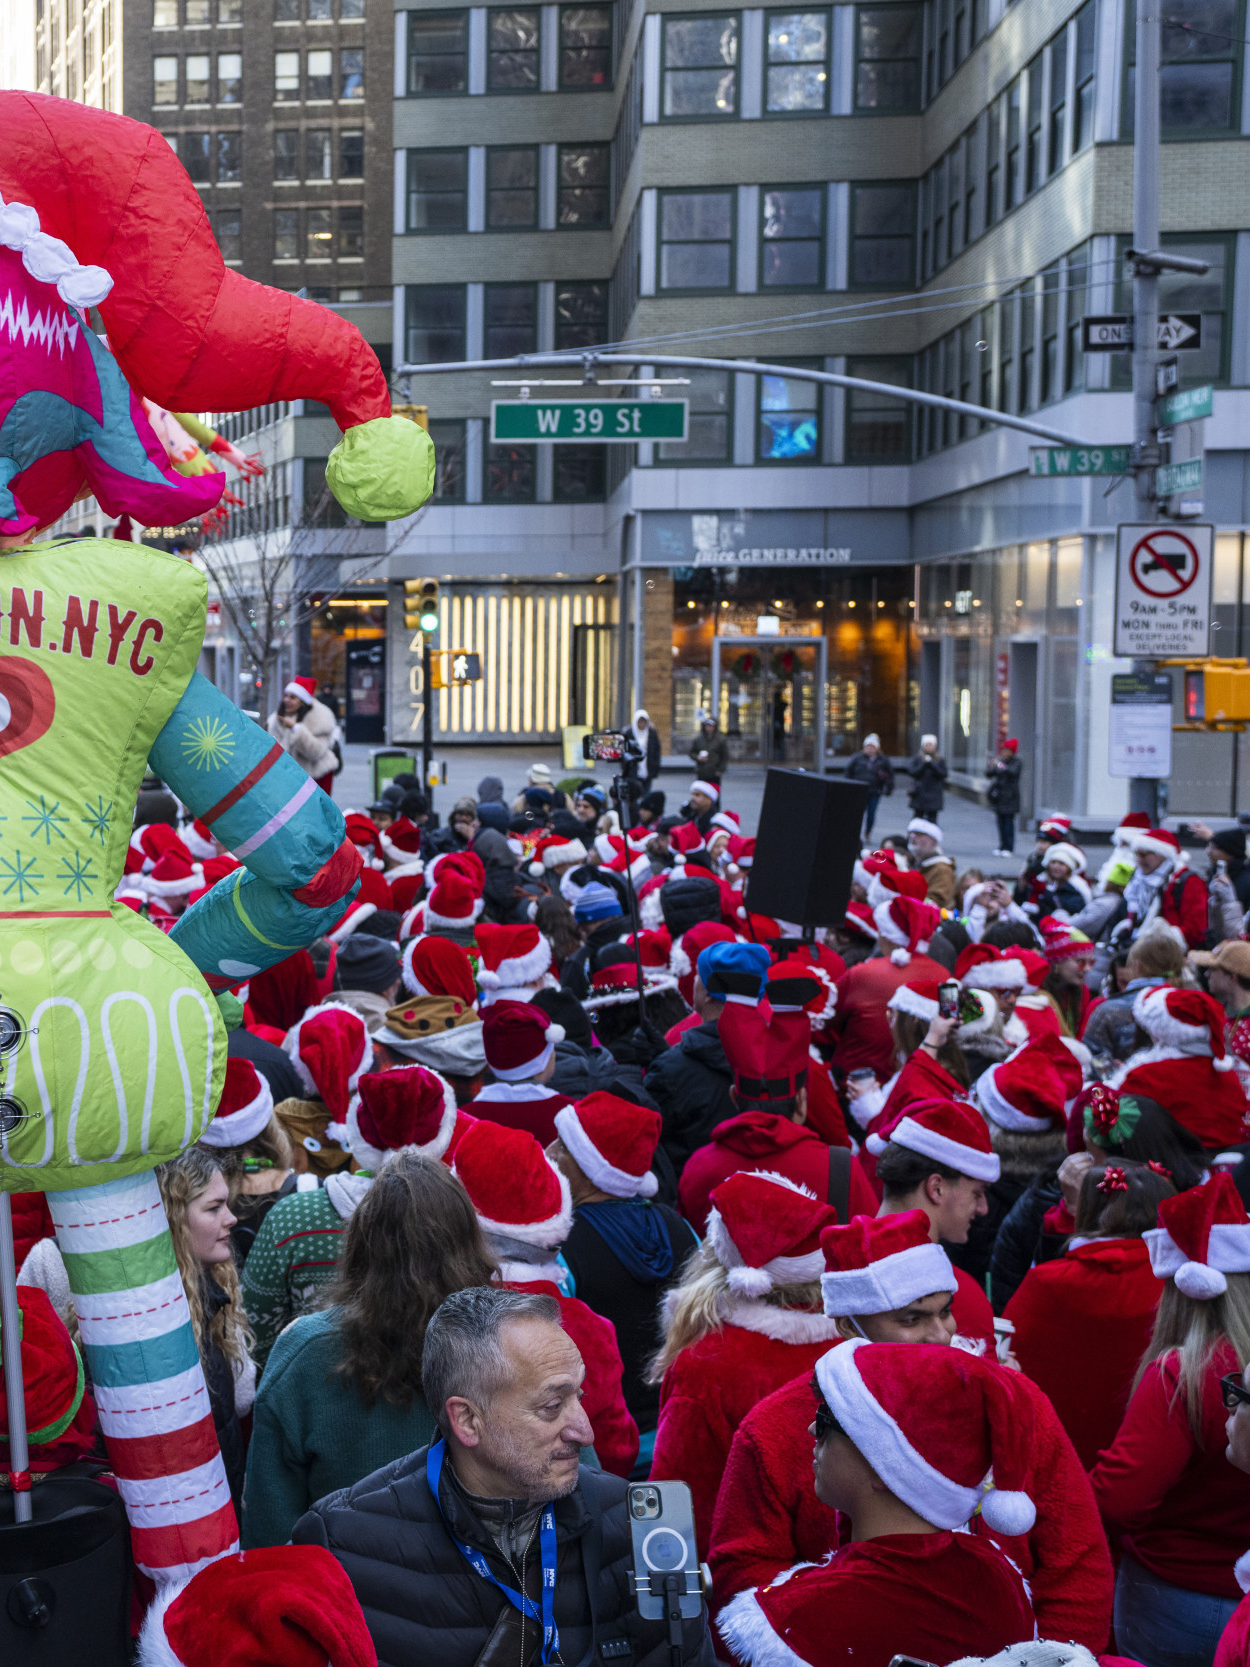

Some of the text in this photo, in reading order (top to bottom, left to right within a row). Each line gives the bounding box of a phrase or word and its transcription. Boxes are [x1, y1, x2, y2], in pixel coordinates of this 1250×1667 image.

[536, 407, 642, 433] W 39 St
[1053, 449, 1071, 473] W
[1076, 449, 1105, 472] 39
[738, 548, 851, 563] GENERATION
[1121, 619, 1203, 630] MON THRU FRI
[1129, 633, 1194, 642] EXCEPT LOCAL
[1136, 643, 1187, 651] DELIVERIES
